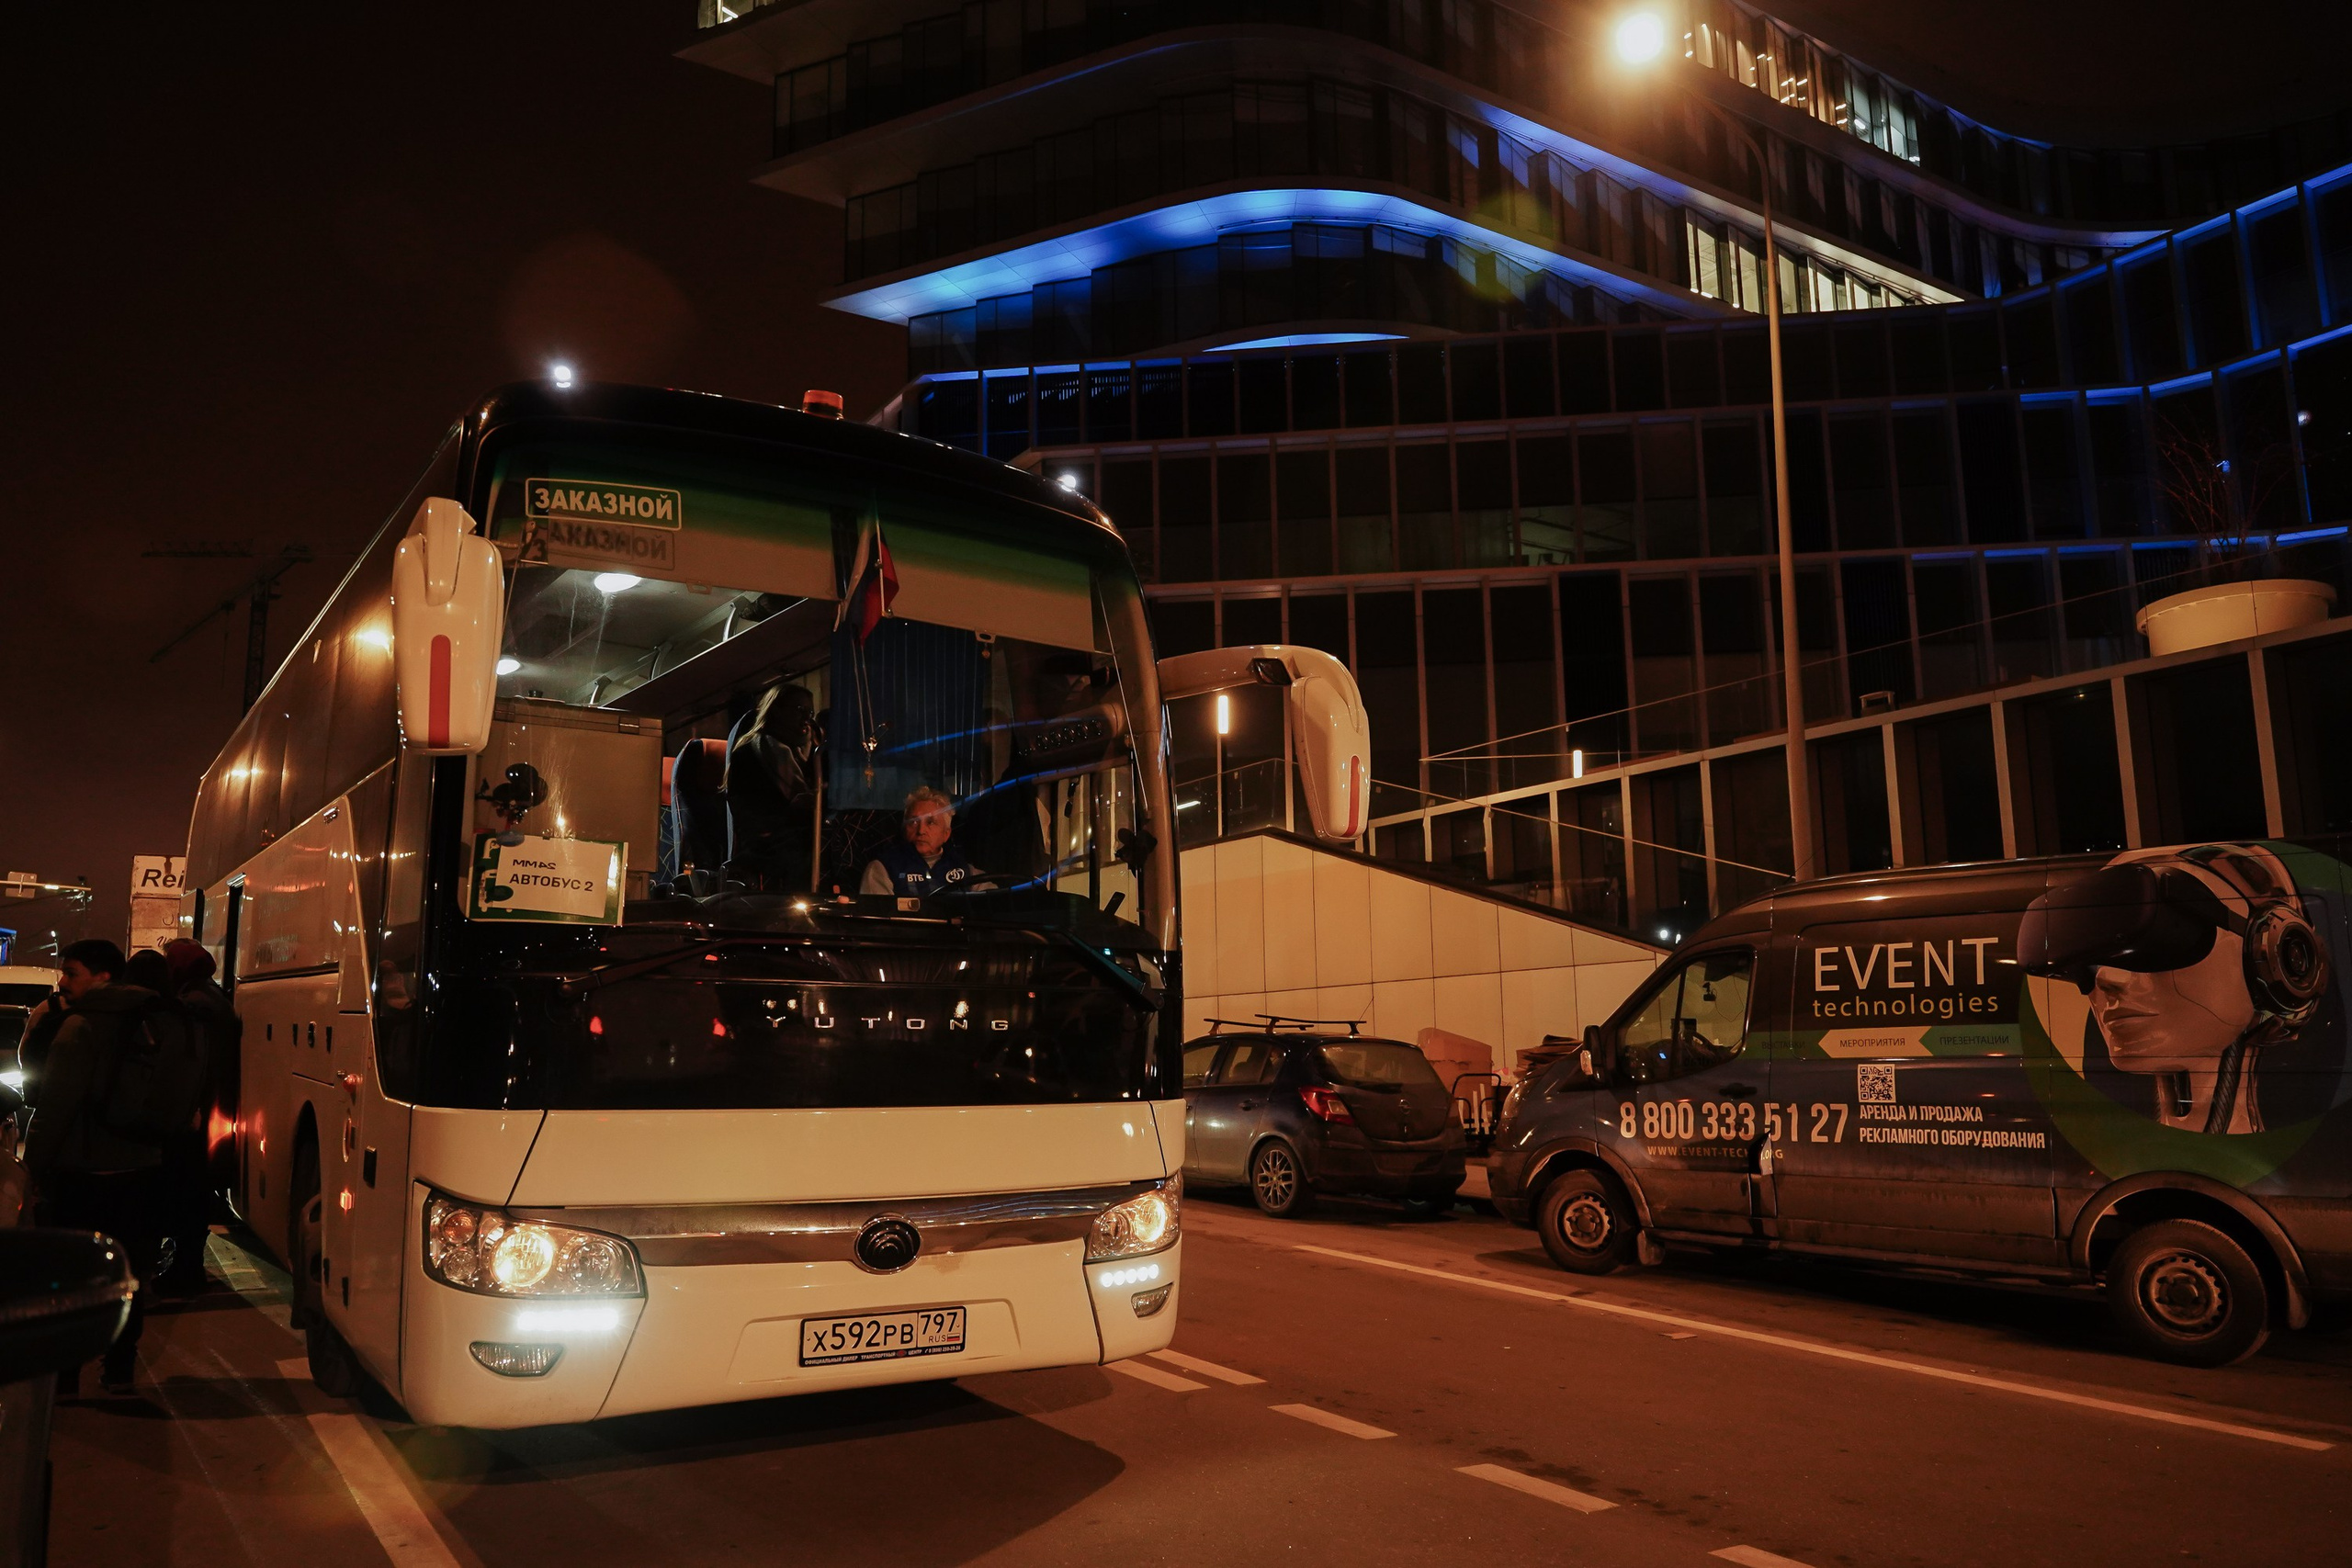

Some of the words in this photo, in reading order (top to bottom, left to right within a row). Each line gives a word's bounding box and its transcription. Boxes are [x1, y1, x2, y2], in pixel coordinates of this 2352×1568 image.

[535, 488, 673, 520] ЗАКАЗНОЙ
[509, 874, 581, 890] АВТОБУС
[584, 881, 594, 892] 2
[907, 874, 924, 882] ВТБ
[1815, 937, 1999, 992] EVENT
[1812, 992, 1999, 1020] technologies
[765, 1015, 1009, 1032] YUTONG
[1839, 1037, 1905, 1048] МЕРОПРИЯТИЯ
[1939, 1035, 2009, 1046] ПРЕЗЕНТАЦИИ
[1620, 1101, 1636, 1138] 8
[1643, 1101, 1694, 1140] 800
[1702, 1102, 1756, 1141] 333
[1764, 1102, 1799, 1143] 51
[1811, 1102, 1849, 1143] 27
[1860, 1104, 1906, 1122] АРЕНДА
[1908, 1105, 1917, 1121] И
[1920, 1105, 1984, 1122] ПРОДАЖА
[1860, 1127, 1939, 1145] РЕКЛАМНОГО
[1941, 1130, 2046, 1149] ОБОРУДОВАНИЯ
[921, 1312, 957, 1335] 797
[812, 1320, 914, 1352] Х592РВ
[928, 1335, 946, 1344] RUS
